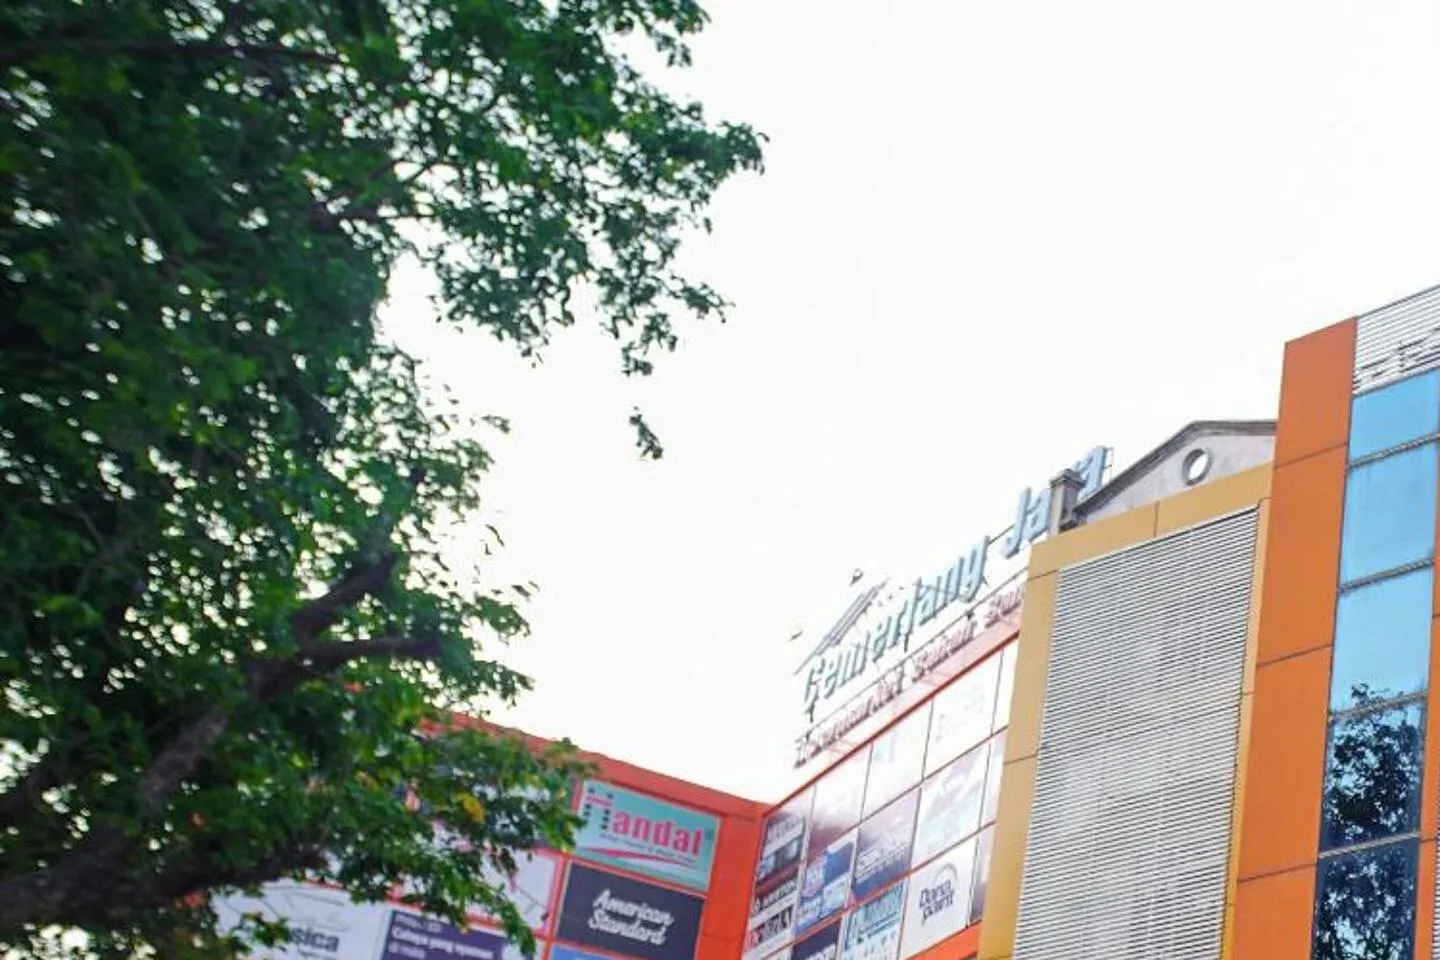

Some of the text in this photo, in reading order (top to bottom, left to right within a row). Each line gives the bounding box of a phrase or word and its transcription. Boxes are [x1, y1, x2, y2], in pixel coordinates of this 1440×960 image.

[1002, 445, 1108, 559] Jaa
[588, 908, 667, 945] Standard
[593, 888, 675, 927] American
